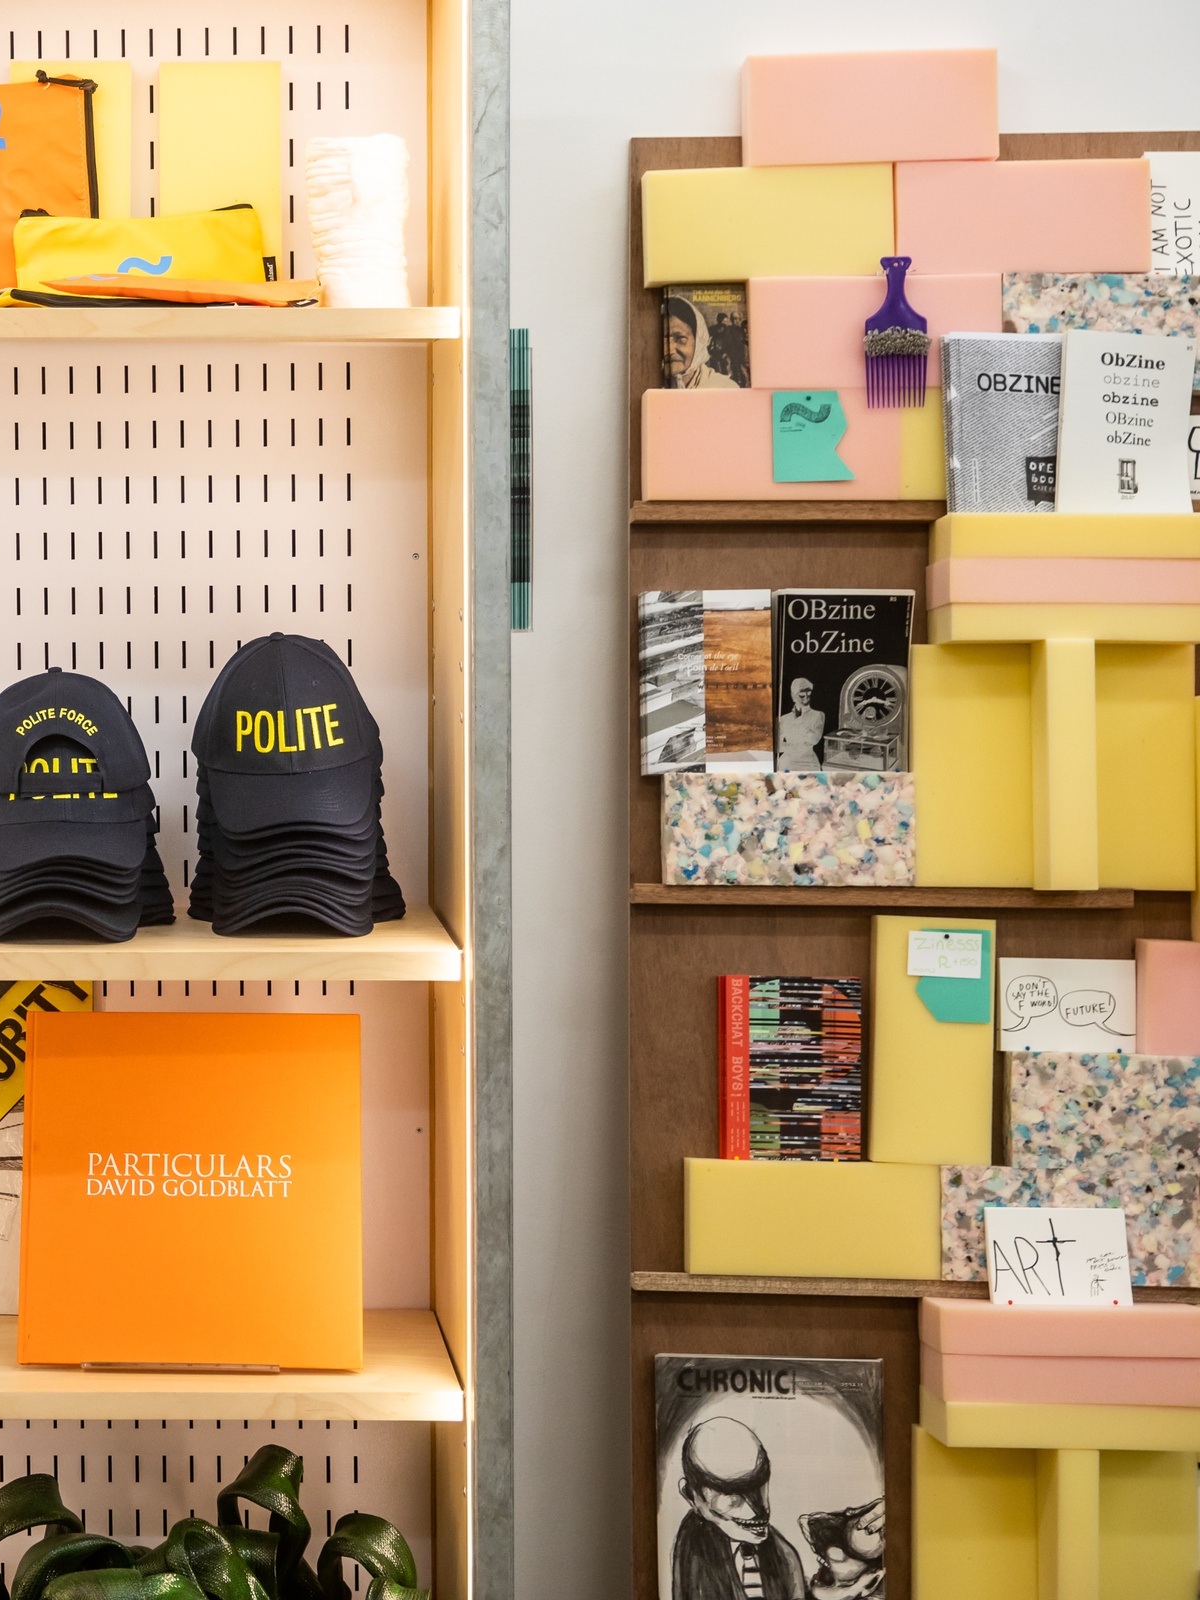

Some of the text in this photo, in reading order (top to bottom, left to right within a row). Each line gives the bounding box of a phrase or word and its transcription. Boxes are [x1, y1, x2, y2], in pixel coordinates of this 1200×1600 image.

[1150, 179, 1167, 217] NOT
[1152, 228, 1170, 256] AM
[1100, 352, 1166, 371] ObZine
[1103, 373, 1160, 389] obzine
[1102, 391, 1159, 407] obzine
[1105, 411, 1154, 428] OBzine
[1106, 430, 1151, 447] obZine
[787, 597, 876, 620] OBzine
[790, 630, 875, 653] obZine
[15, 707, 99, 737] POLITE FORCE
[235, 703, 345, 754] POLITE
[1012, 989, 1050, 1000] SAY THE
[1019, 979, 1049, 992] DON'T
[731, 978, 744, 1047] BACKCHAT
[1018, 1000, 1025, 1011] F
[87, 1152, 293, 1179] PARTICULARS
[86, 1178, 293, 1198] DAVID GOLDBLATT
[993, 1218, 1076, 1296] ART
[676, 1367, 791, 1395] CHRONIC
